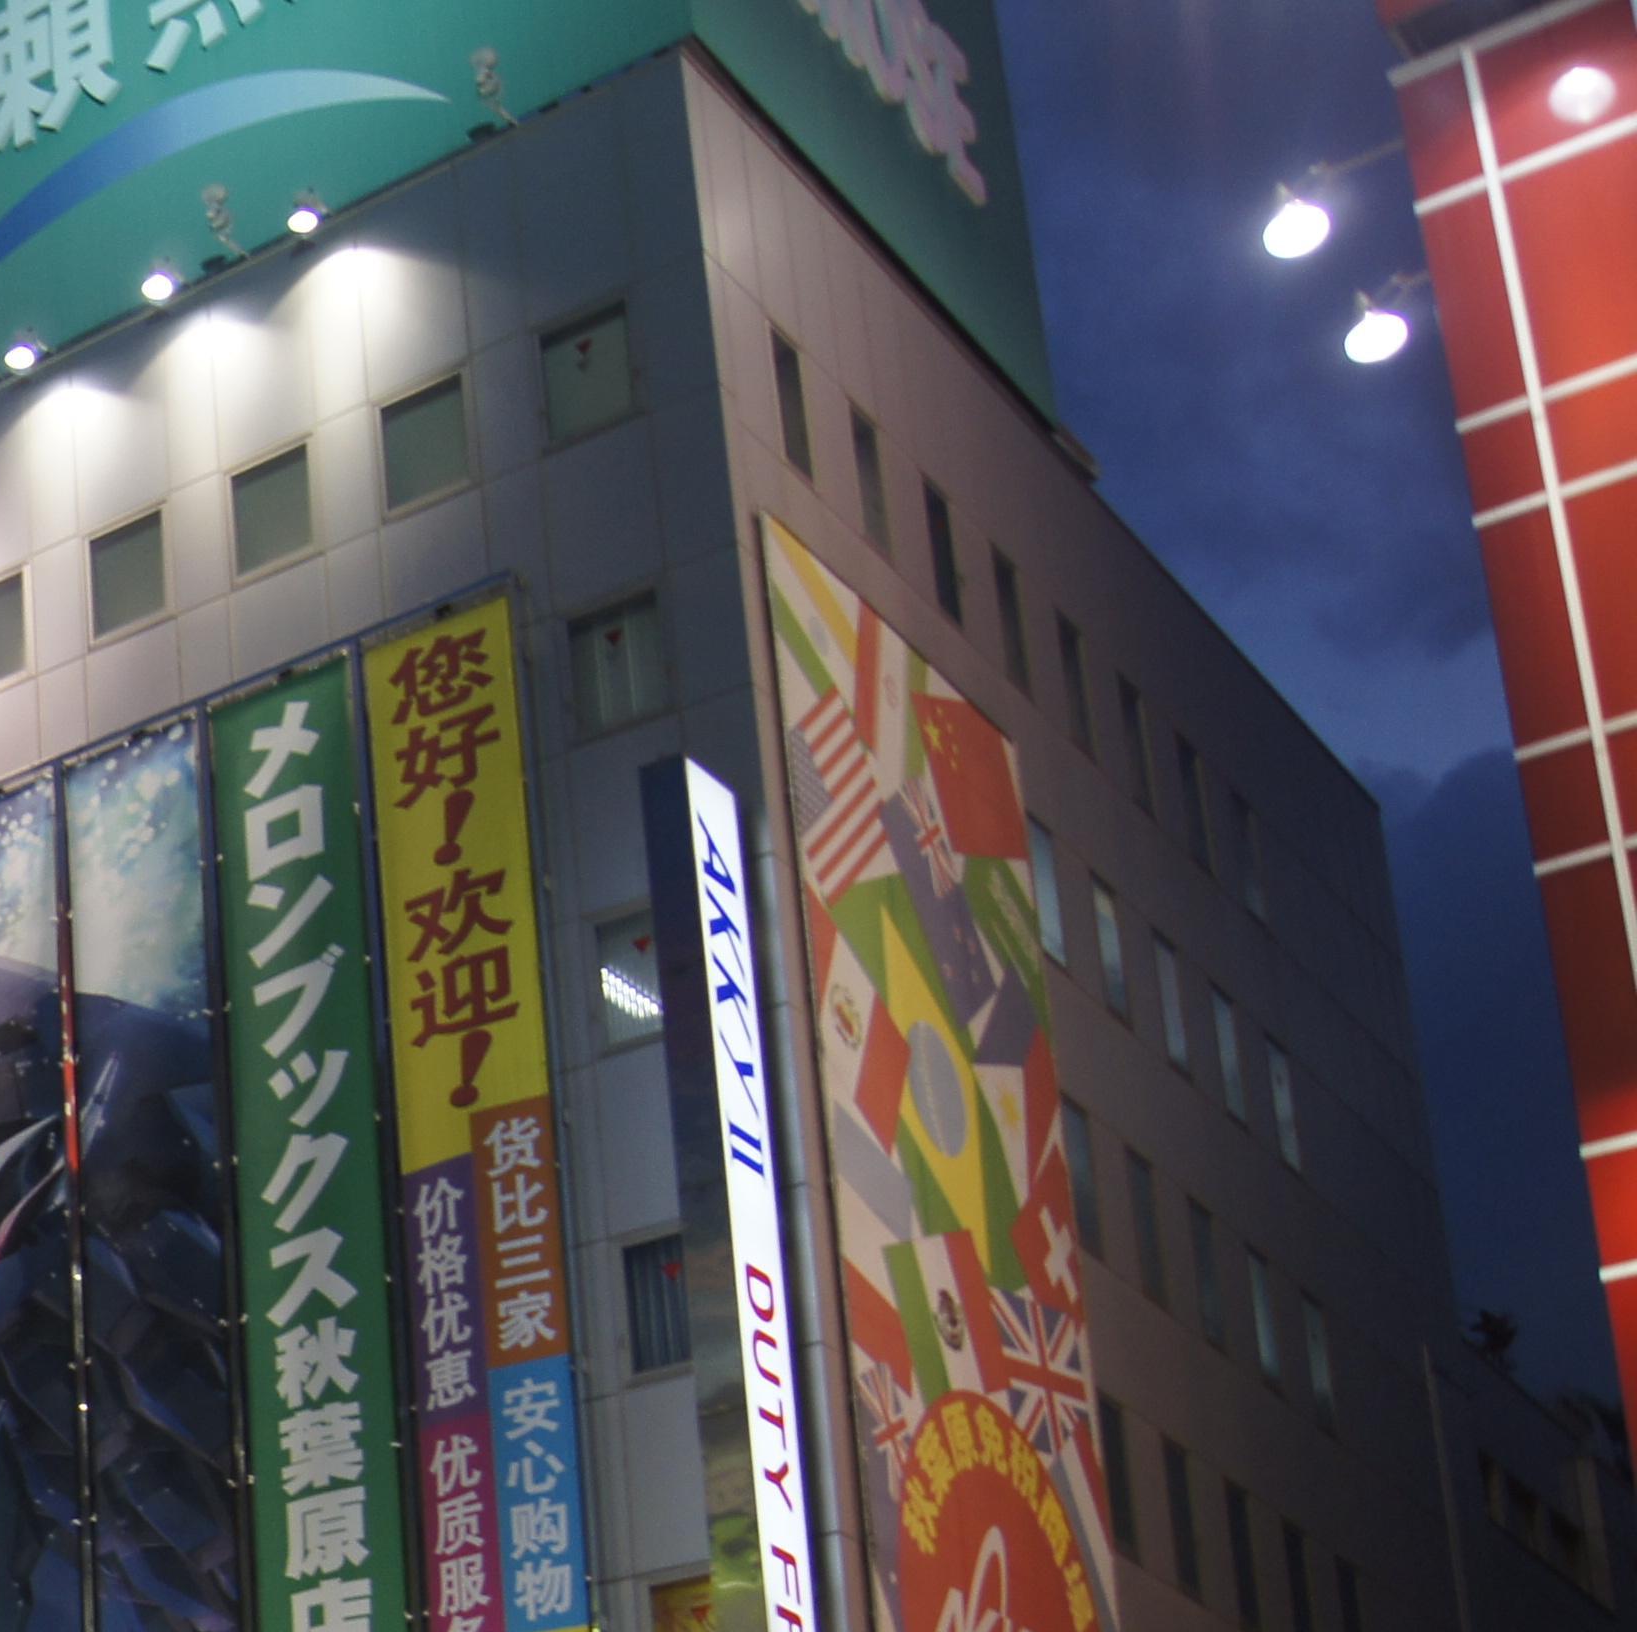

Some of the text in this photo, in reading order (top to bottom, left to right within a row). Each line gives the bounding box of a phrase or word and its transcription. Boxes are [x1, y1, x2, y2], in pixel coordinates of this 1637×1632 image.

[483, 1116, 557, 1352] 货比三家
[696, 810, 763, 1118] AKKY
[744, 1261, 795, 1513] DUTY
[411, 1176, 477, 1413] 价格优惠
[501, 1377, 574, 1622] 安心购物
